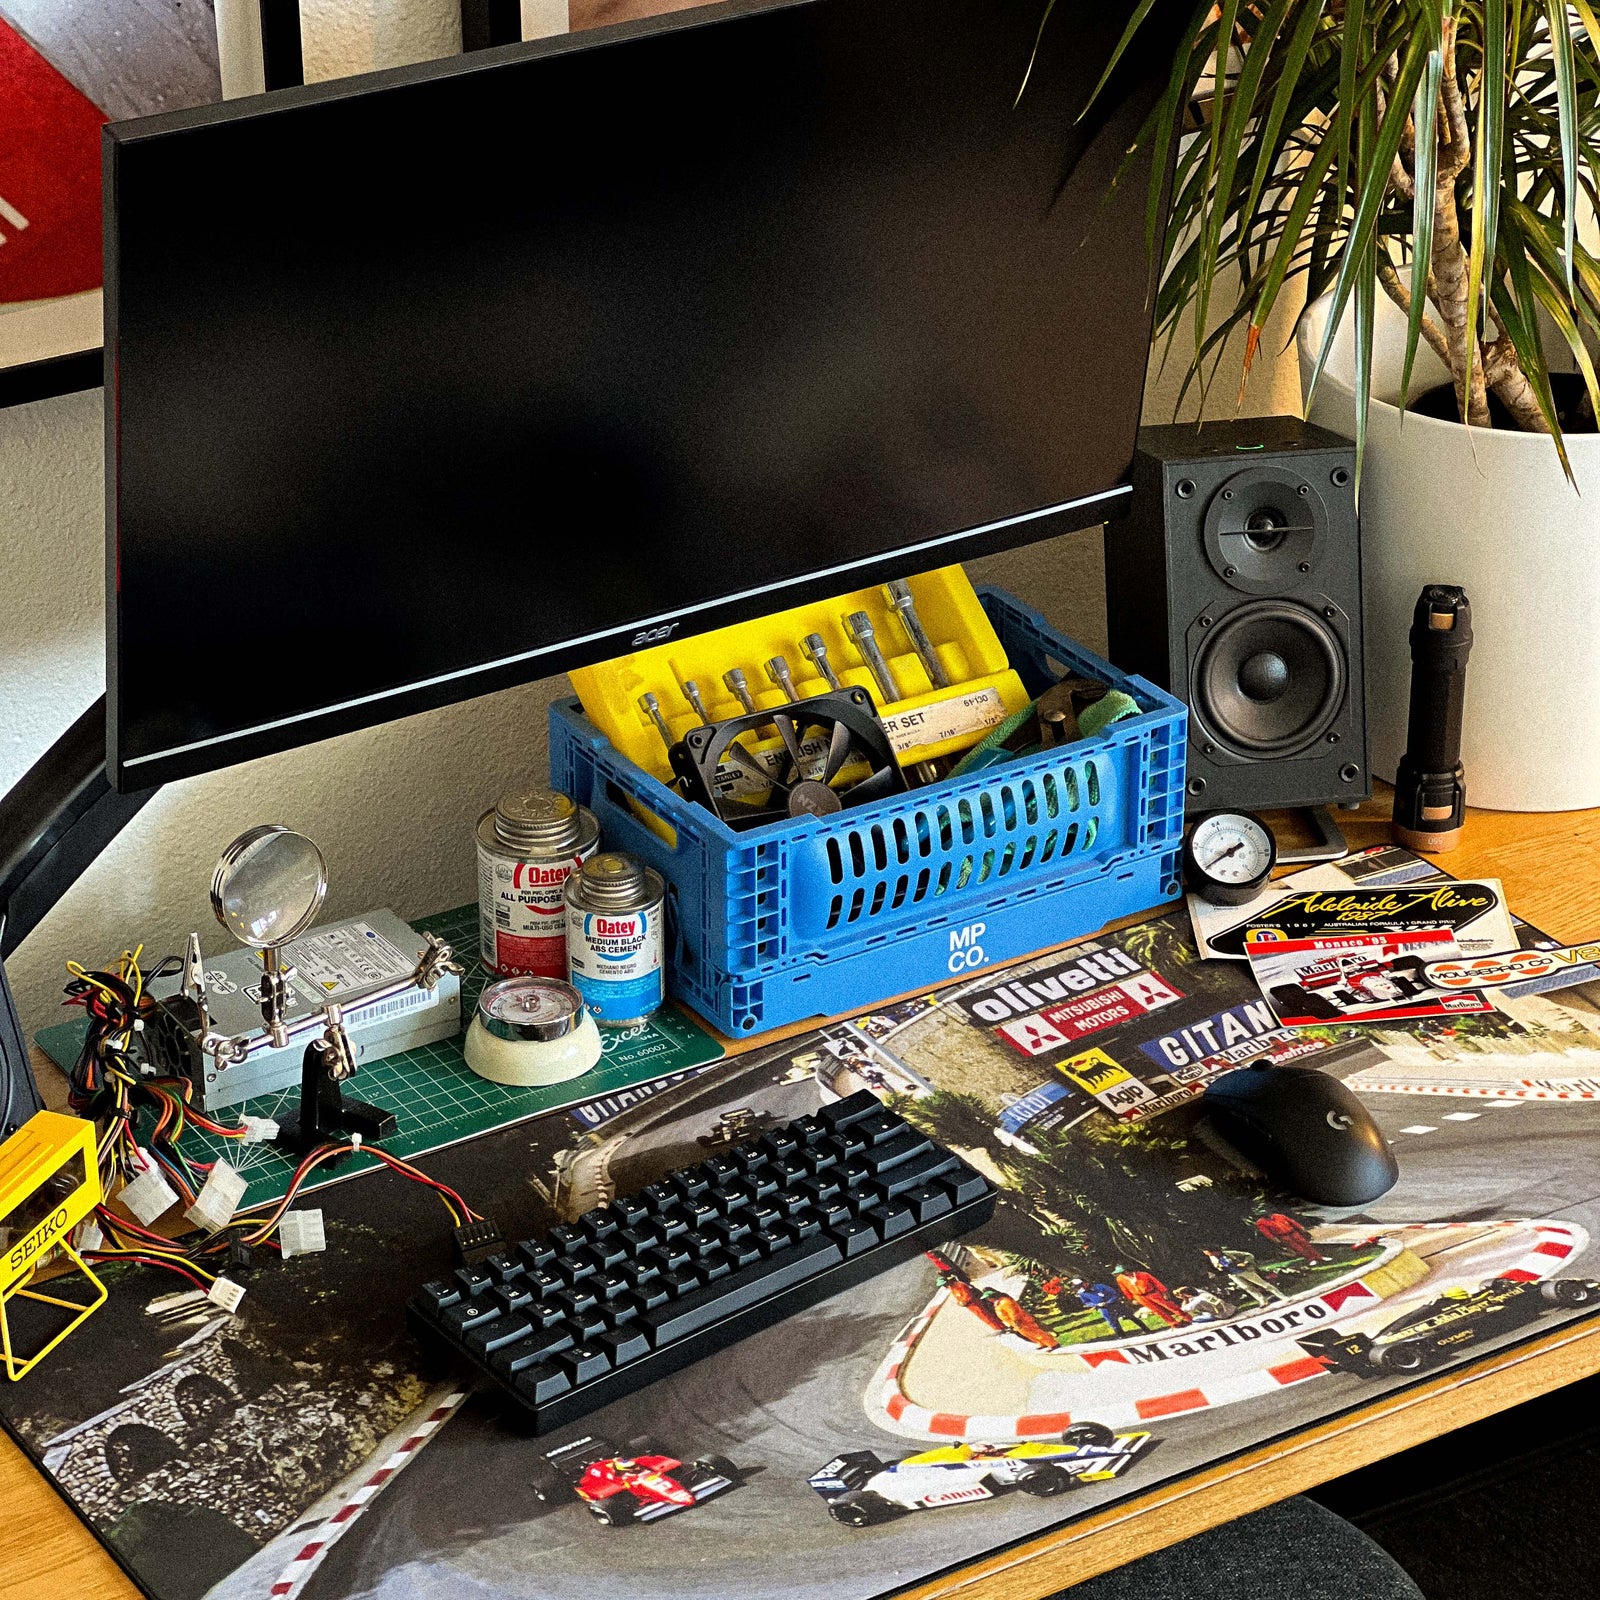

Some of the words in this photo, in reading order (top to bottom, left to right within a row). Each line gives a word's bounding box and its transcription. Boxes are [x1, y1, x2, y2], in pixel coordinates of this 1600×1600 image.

[632, 622, 680, 646] acer
[963, 694, 989, 707] 61-130
[900, 712, 926, 728] SET
[529, 866, 571, 884] Oatey
[500, 891, 516, 902] ALL
[518, 894, 562, 904] PURPOSE
[1262, 891, 1402, 919] Adelaide
[1388, 885, 1489, 915] Alive
[1336, 910, 1389, 921] 1987
[596, 918, 636, 936] Oatey
[950, 922, 986, 951] MP
[585, 935, 619, 946] MEDIUM
[621, 934, 647, 945] BLACK
[590, 944, 607, 952] ABS
[608, 942, 643, 953] CEMENT
[1313, 937, 1364, 950] Monaco
[1365, 936, 1388, 945] '95
[948, 945, 990, 973] CO.
[1300, 955, 1368, 976] Marlro
[1430, 963, 1525, 980] MOUSEPAD
[1529, 957, 1554, 968] CO
[1551, 945, 1600, 963] V8
[972, 947, 1142, 1022] olivetti
[1049, 985, 1125, 1024] MITSUBISHI
[1444, 998, 1482, 1010] Marlboro
[1073, 1005, 1130, 1032] MOTORS
[640, 1032, 660, 1041] USA
[1158, 1000, 1277, 1067] GITAN
[1220, 1028, 1299, 1062] Marlbro
[1105, 1085, 1144, 1107] Agip
[1138, 1089, 1193, 1116] Marlboro
[10, 1208, 68, 1272] SEIKO
[1125, 1304, 1327, 1365] Marlboro
[1345, 1344, 1363, 1355] 12
[924, 1487, 987, 1503] Canon
